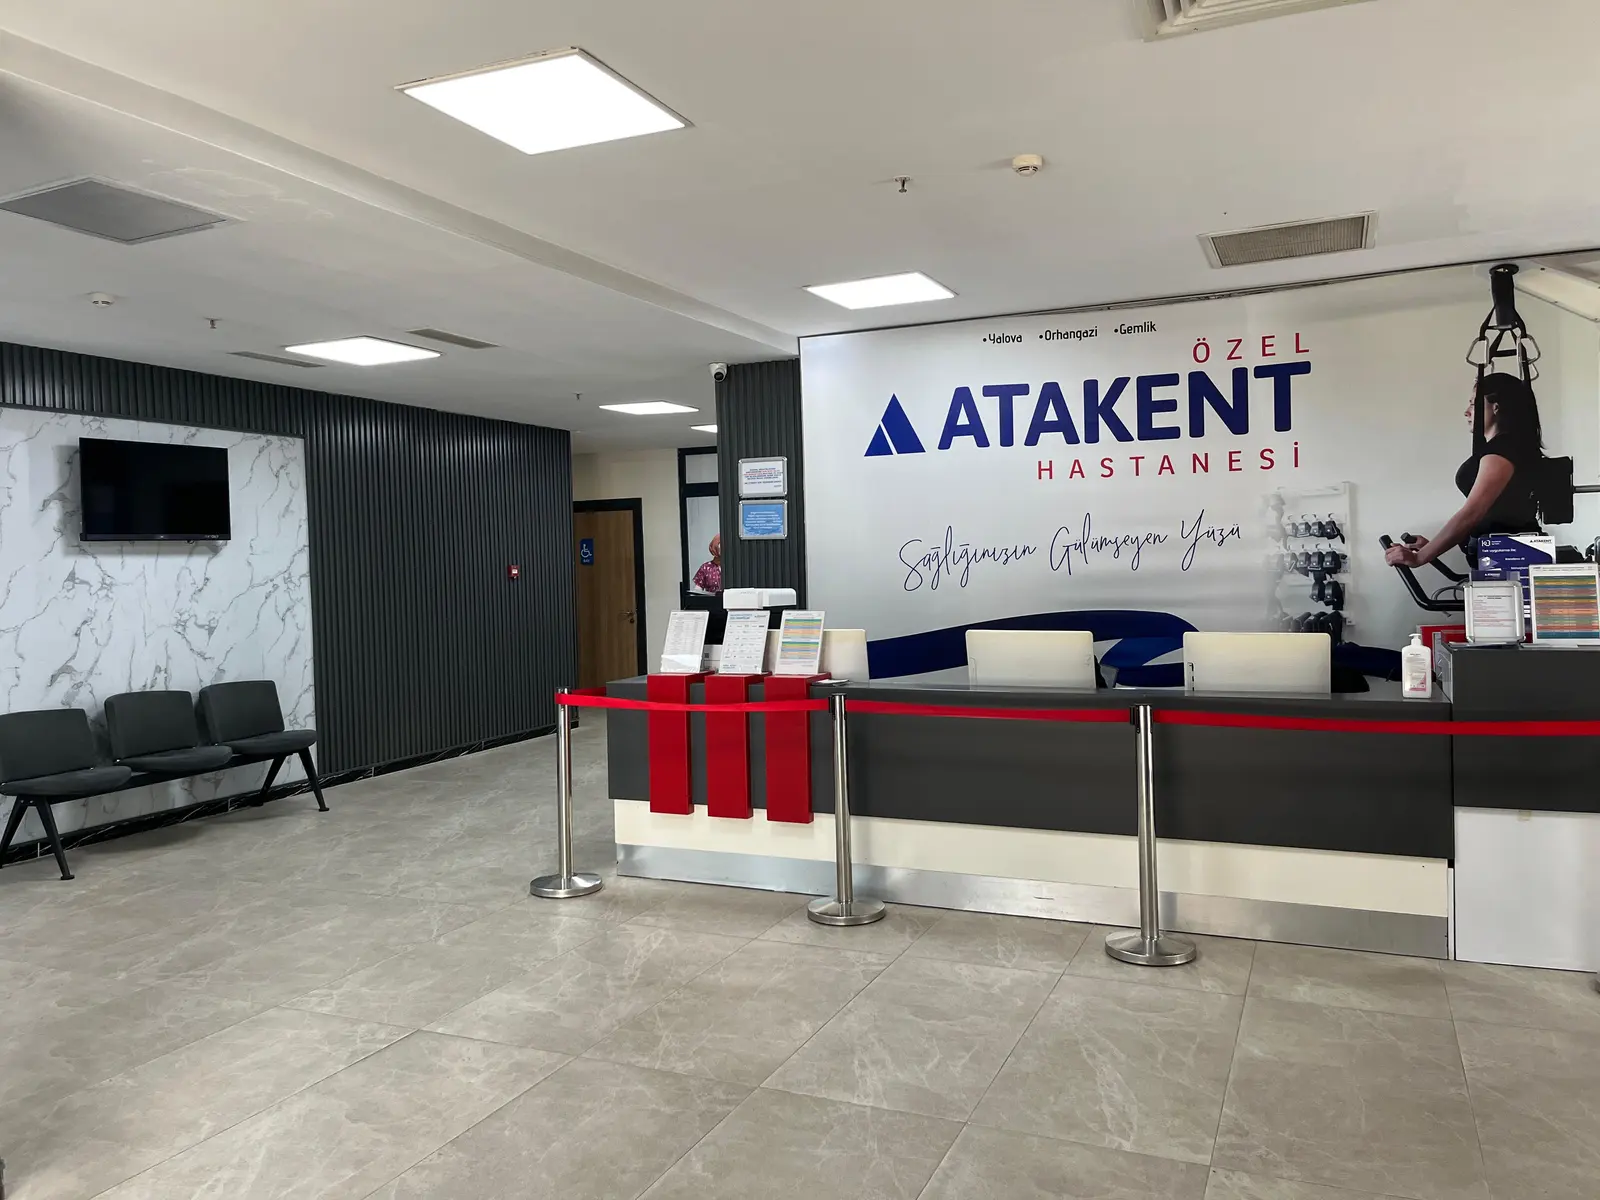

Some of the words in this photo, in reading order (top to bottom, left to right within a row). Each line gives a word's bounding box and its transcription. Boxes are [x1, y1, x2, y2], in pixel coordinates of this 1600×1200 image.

[988, 332, 1023, 345] Yalova
[1044, 325, 1098, 341] Orhangazi
[1119, 320, 1157, 335] Gemlik
[1192, 333, 1309, 364] ÖZEL
[937, 360, 1312, 451] ATAKENT
[1037, 440, 1300, 480] HASTANESİ
[1180, 508, 1242, 572] Yüzü
